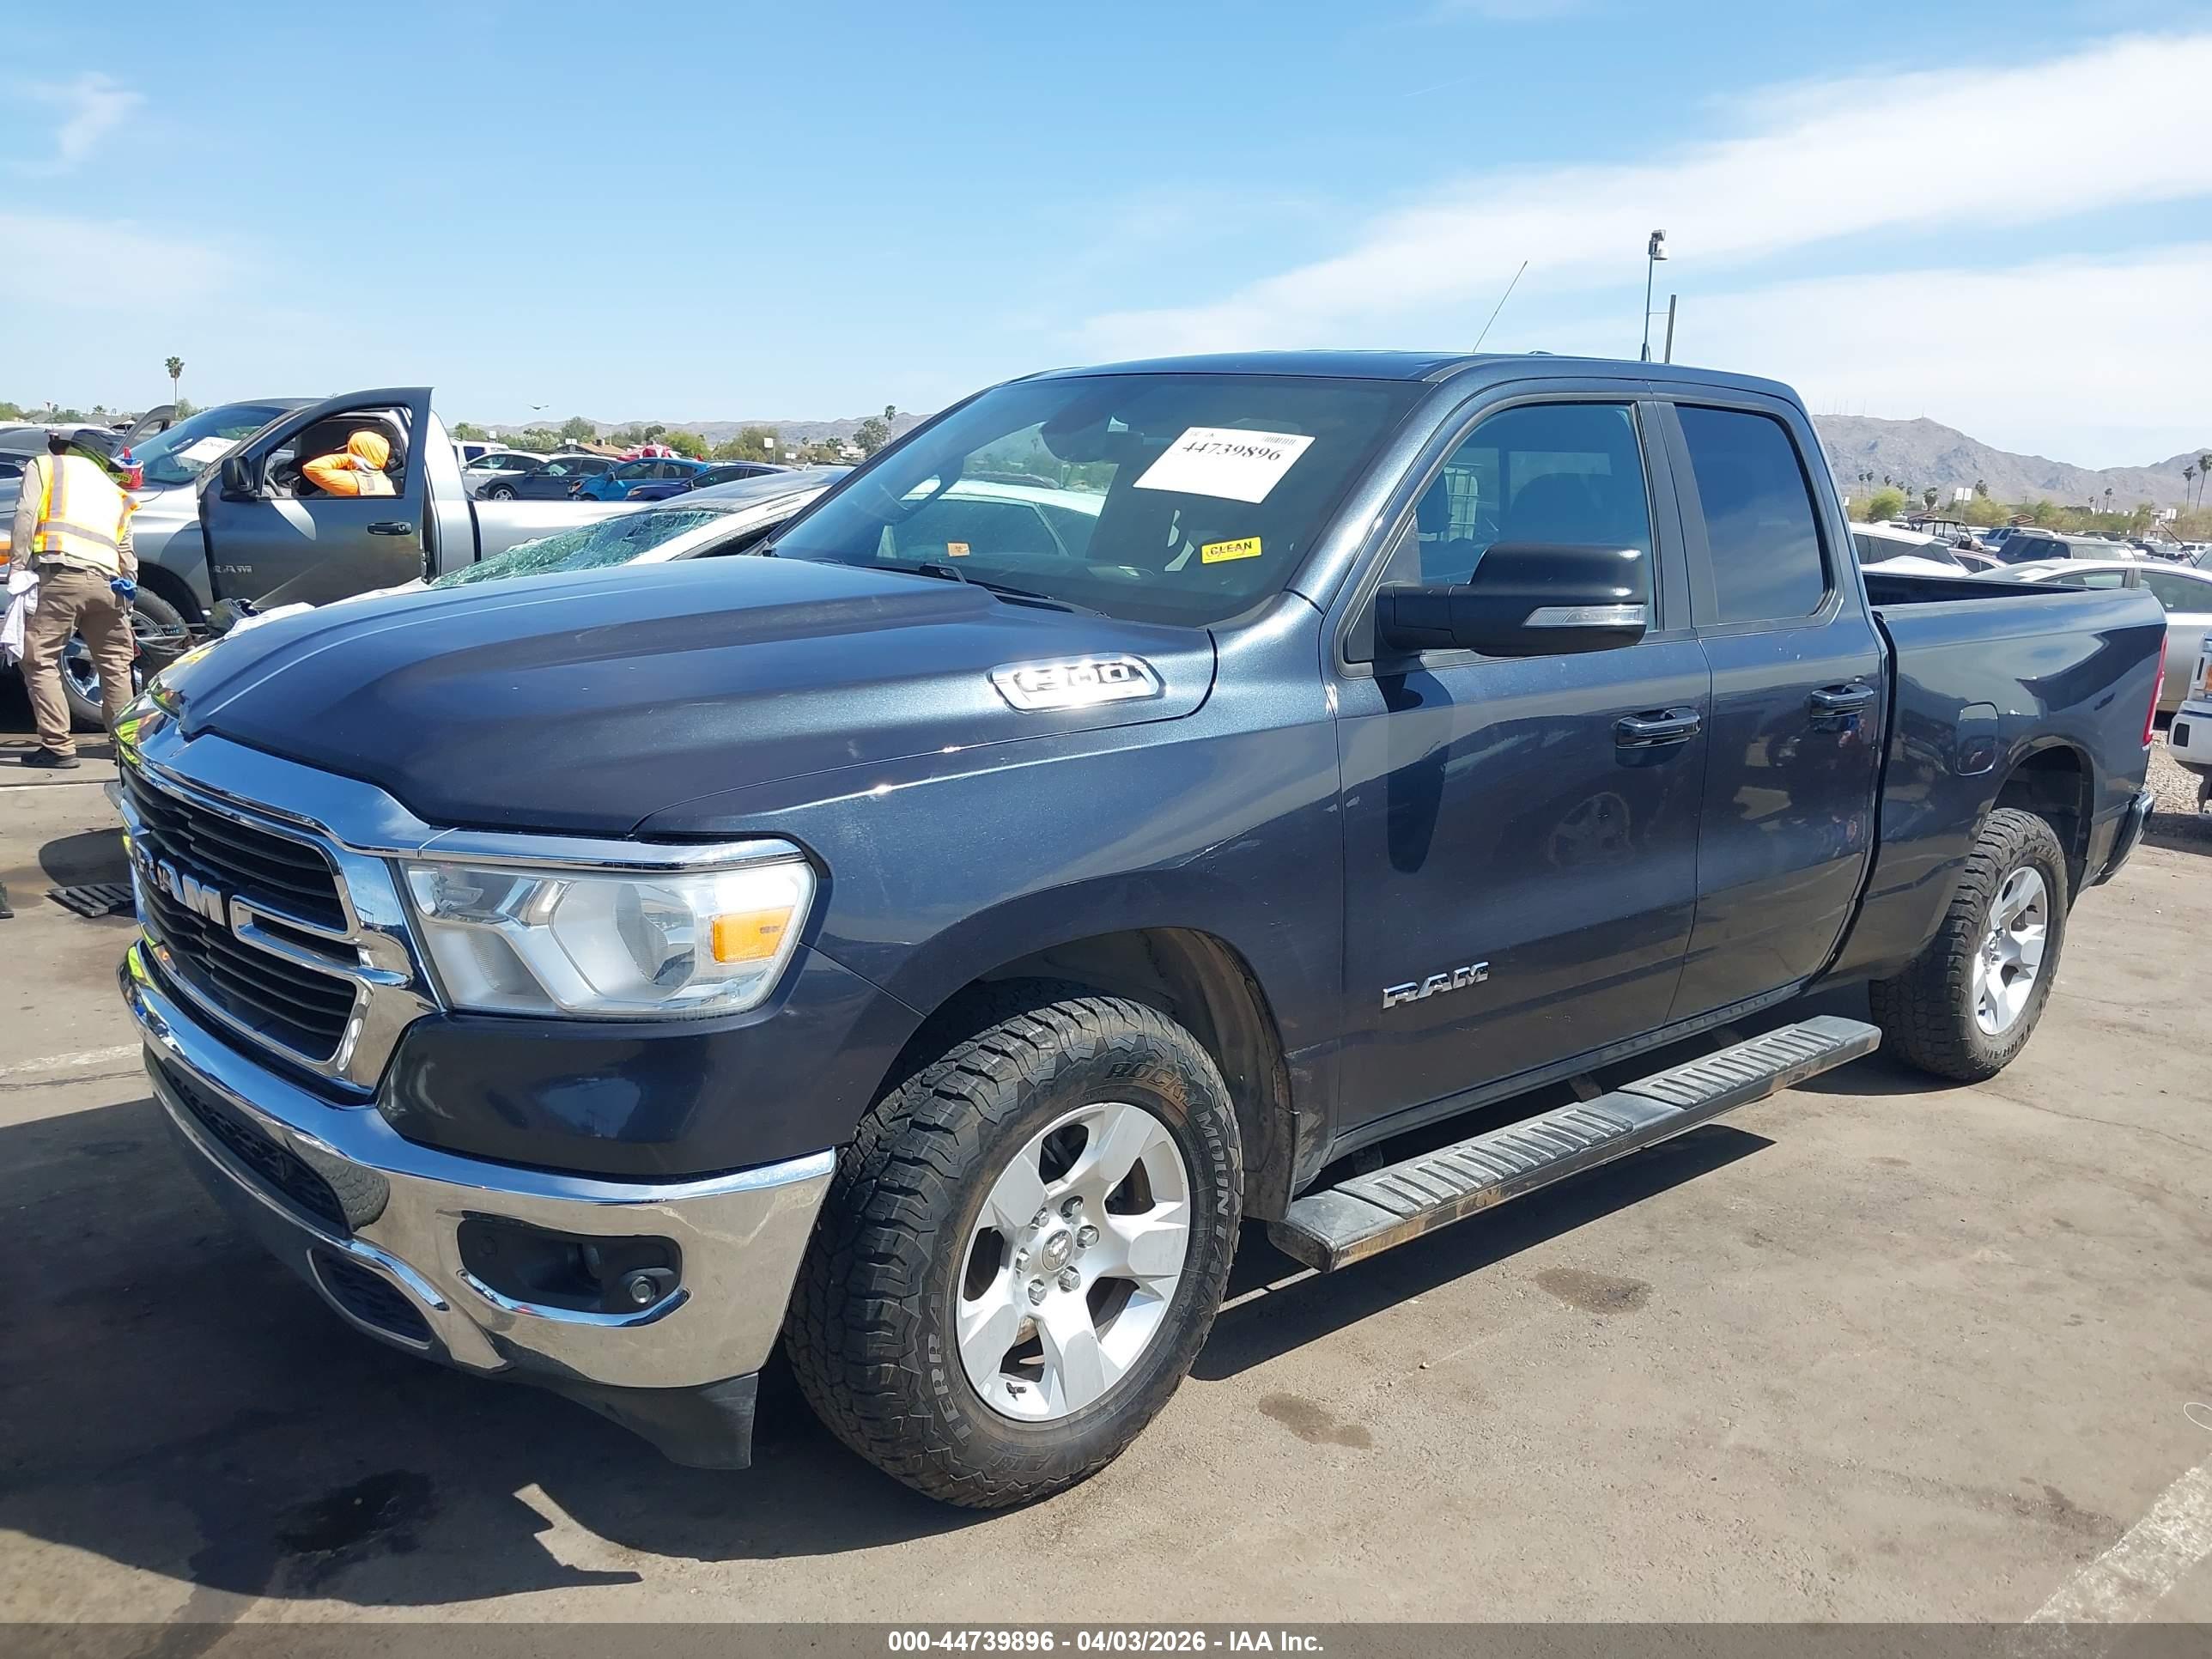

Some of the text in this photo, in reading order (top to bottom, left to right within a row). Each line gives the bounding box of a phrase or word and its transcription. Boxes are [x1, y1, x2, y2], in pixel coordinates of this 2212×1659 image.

[1182, 441, 1284, 461] 44739896
[1210, 541, 1253, 555] CLEAN
[134, 841, 225, 927] RAM
[1382, 962, 1489, 1009] RAM
